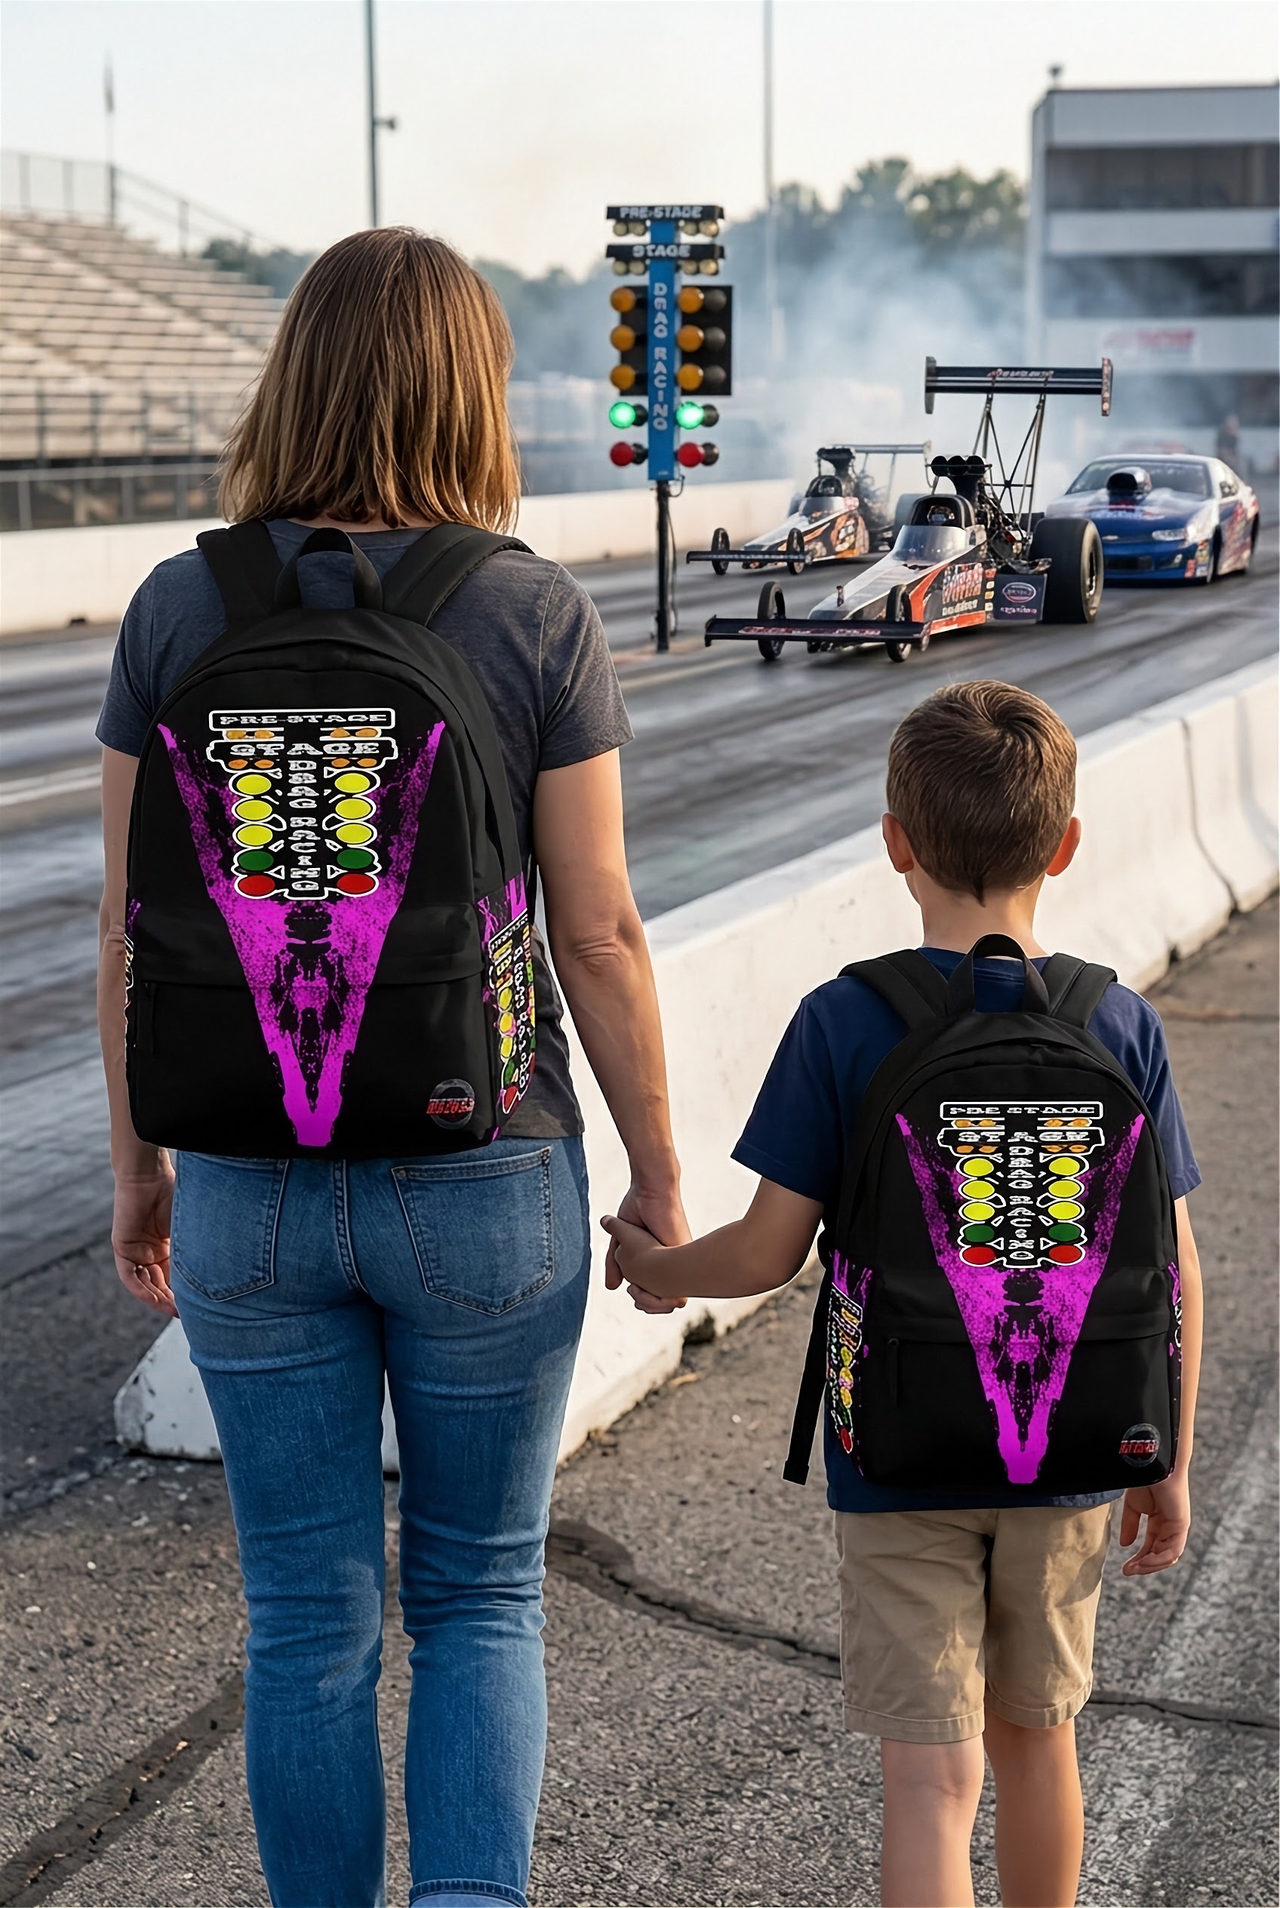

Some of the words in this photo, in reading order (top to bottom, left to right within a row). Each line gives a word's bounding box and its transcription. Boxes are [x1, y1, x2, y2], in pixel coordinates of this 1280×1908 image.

[620, 206, 703, 219] PRE-STAGE
[632, 244, 691, 258] STAGE
[653, 282, 668, 338] DRAG
[652, 346, 669, 431] RACING
[230, 743, 379, 756] STAGE
[287, 760, 320, 809] DRAG
[288, 817, 321, 891] RACING
